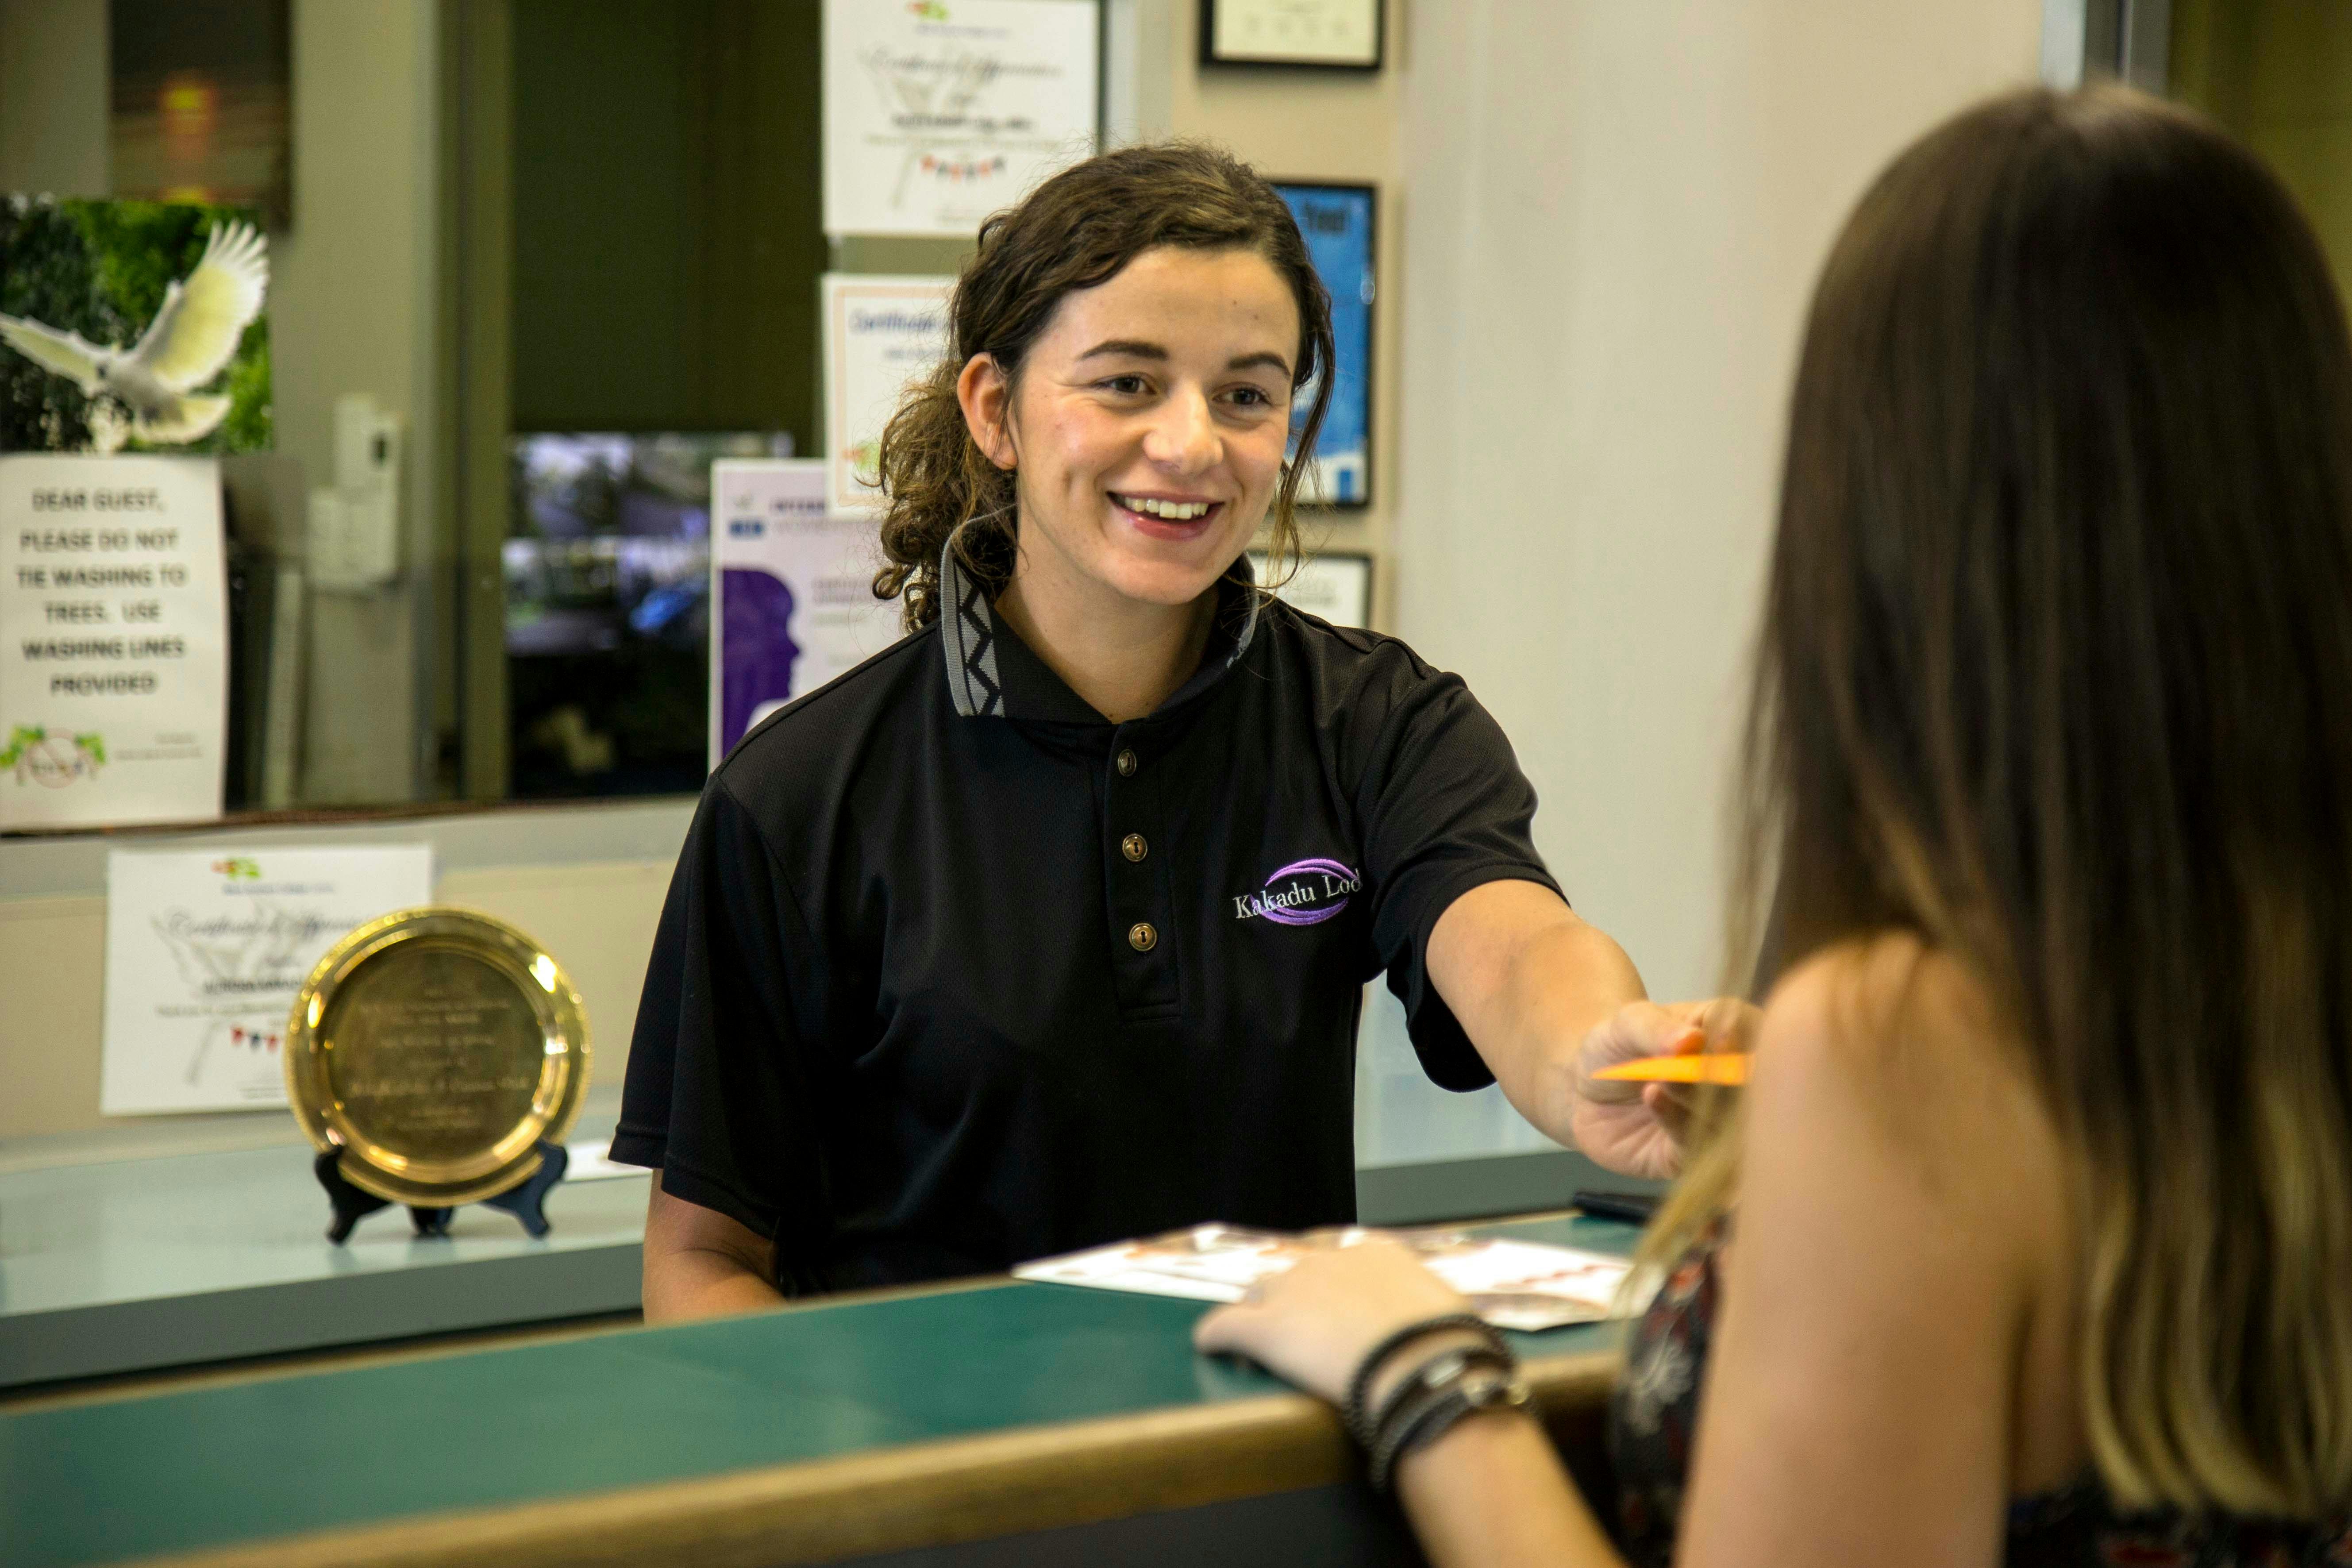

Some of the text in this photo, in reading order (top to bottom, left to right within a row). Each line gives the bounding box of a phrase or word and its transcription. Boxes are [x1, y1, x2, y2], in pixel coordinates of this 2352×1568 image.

[32, 488, 88, 512] DEAR
[20, 527, 179, 552] PLEASE DO NOT
[18, 562, 189, 588] TIE WASHING TO
[122, 599, 162, 622] USE
[22, 634, 186, 660] WASHING LINES
[50, 672, 159, 697] PROVIDED
[1232, 882, 1317, 918] Kakadu
